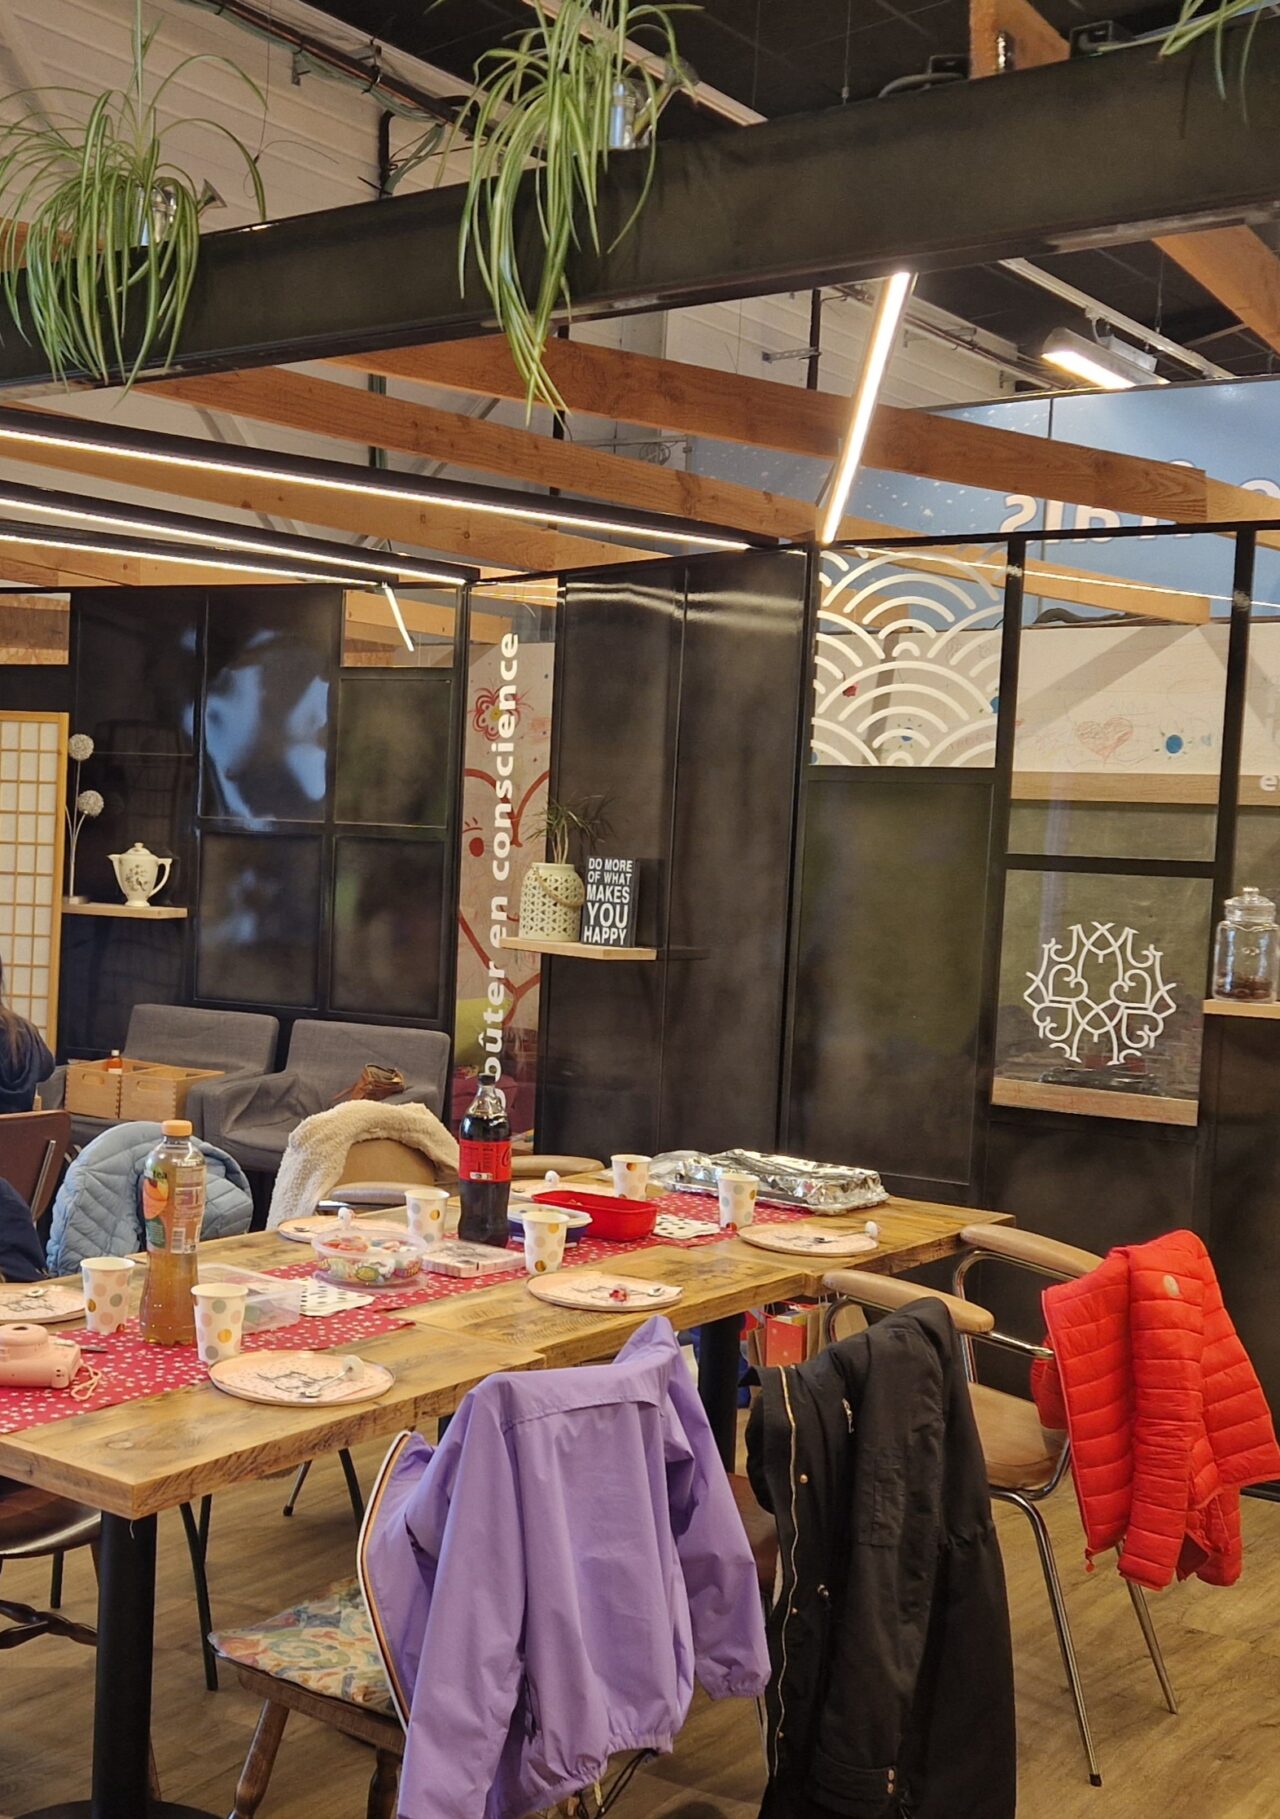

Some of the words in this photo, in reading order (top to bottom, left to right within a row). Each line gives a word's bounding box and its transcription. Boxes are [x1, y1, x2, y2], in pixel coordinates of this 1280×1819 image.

[491, 632, 519, 882] conscience
[588, 857, 602, 870] DO
[604, 858, 633, 872] MORE
[587, 870, 601, 883] OF
[603, 871, 632, 885] WHAT
[586, 884, 630, 903] MAKES
[488, 896, 508, 948] en
[587, 902, 629, 929] YOU
[583, 925, 628, 945] HAPPY
